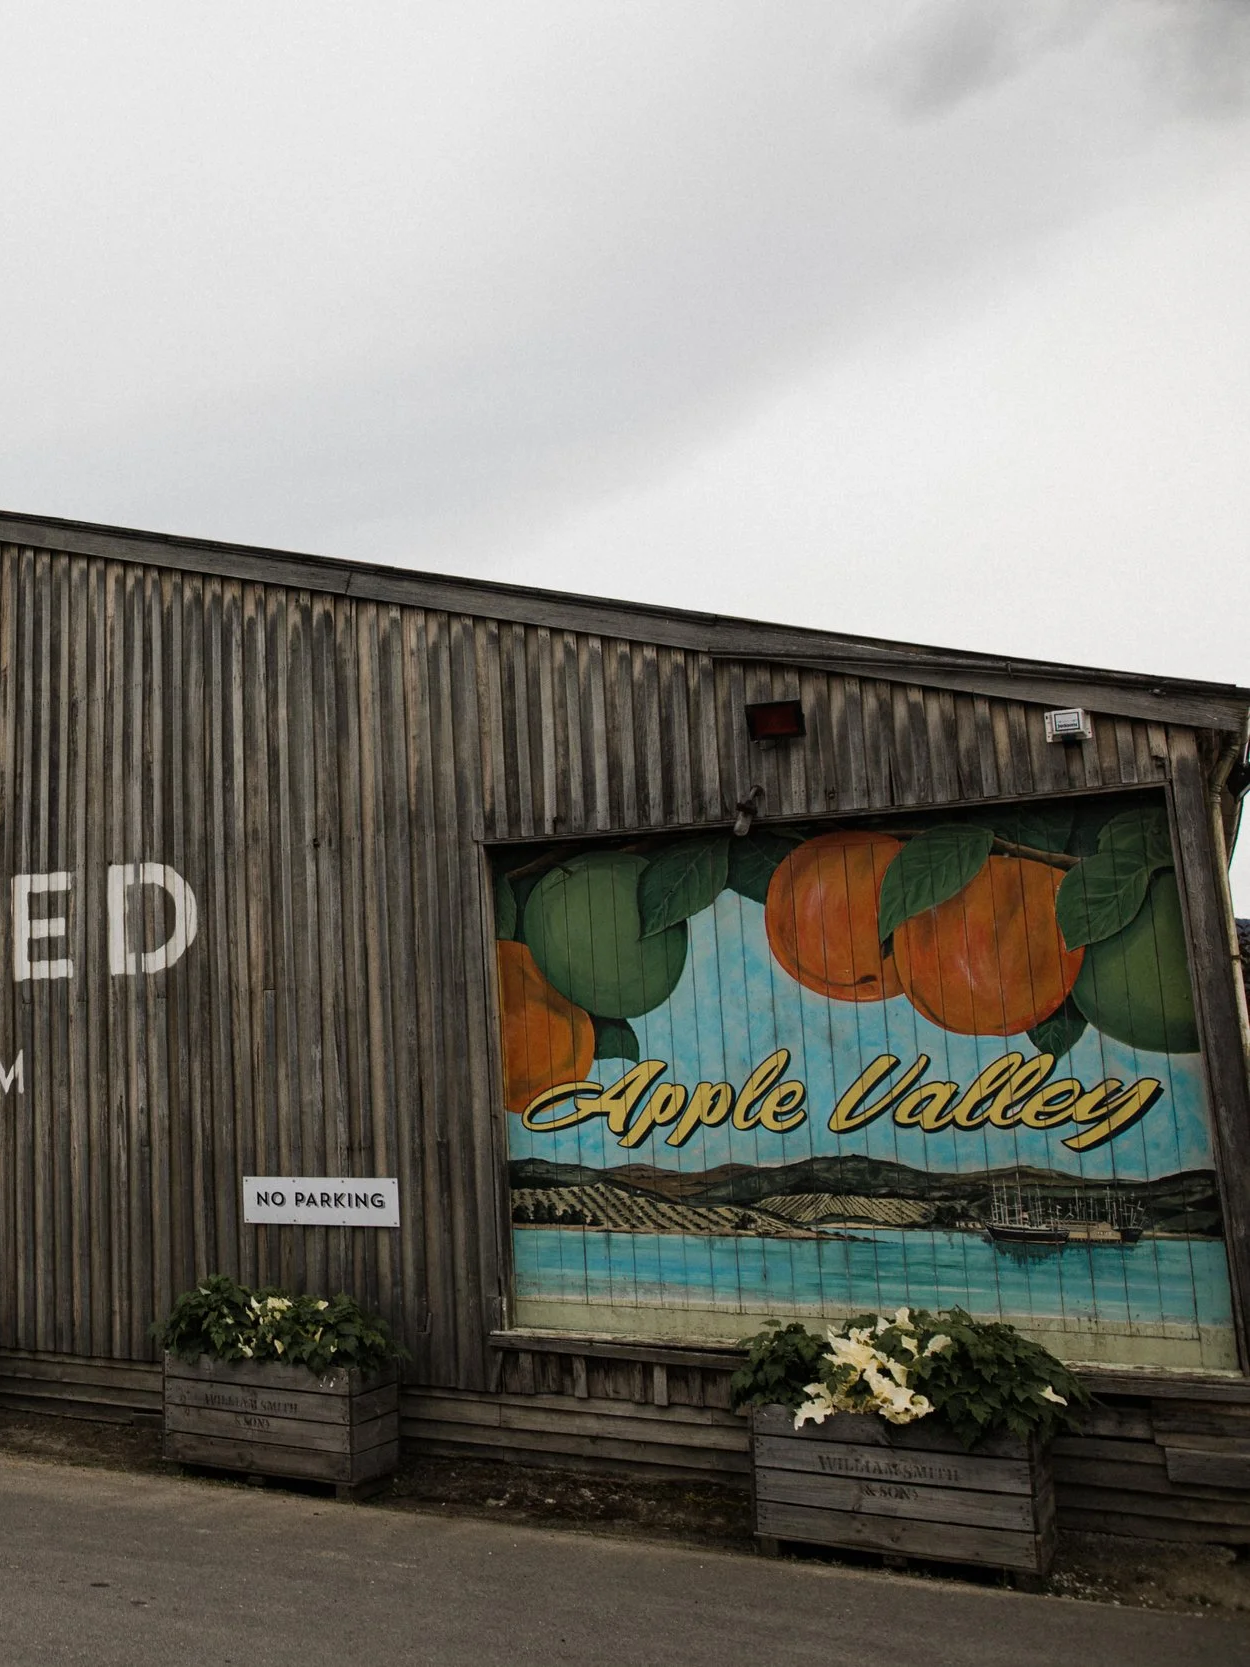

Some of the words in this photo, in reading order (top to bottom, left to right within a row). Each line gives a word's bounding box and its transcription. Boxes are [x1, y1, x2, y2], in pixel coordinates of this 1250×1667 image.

[522, 1048, 808, 1148] Apple
[828, 1052, 1165, 1153] Valley
[256, 1191, 286, 1207] NO
[295, 1192, 385, 1209] PARKING
[205, 1393, 258, 1411] WILLIAM
[260, 1401, 299, 1415] SMITH
[818, 1455, 899, 1476] WILLIAM
[903, 1465, 959, 1481] SMITH
